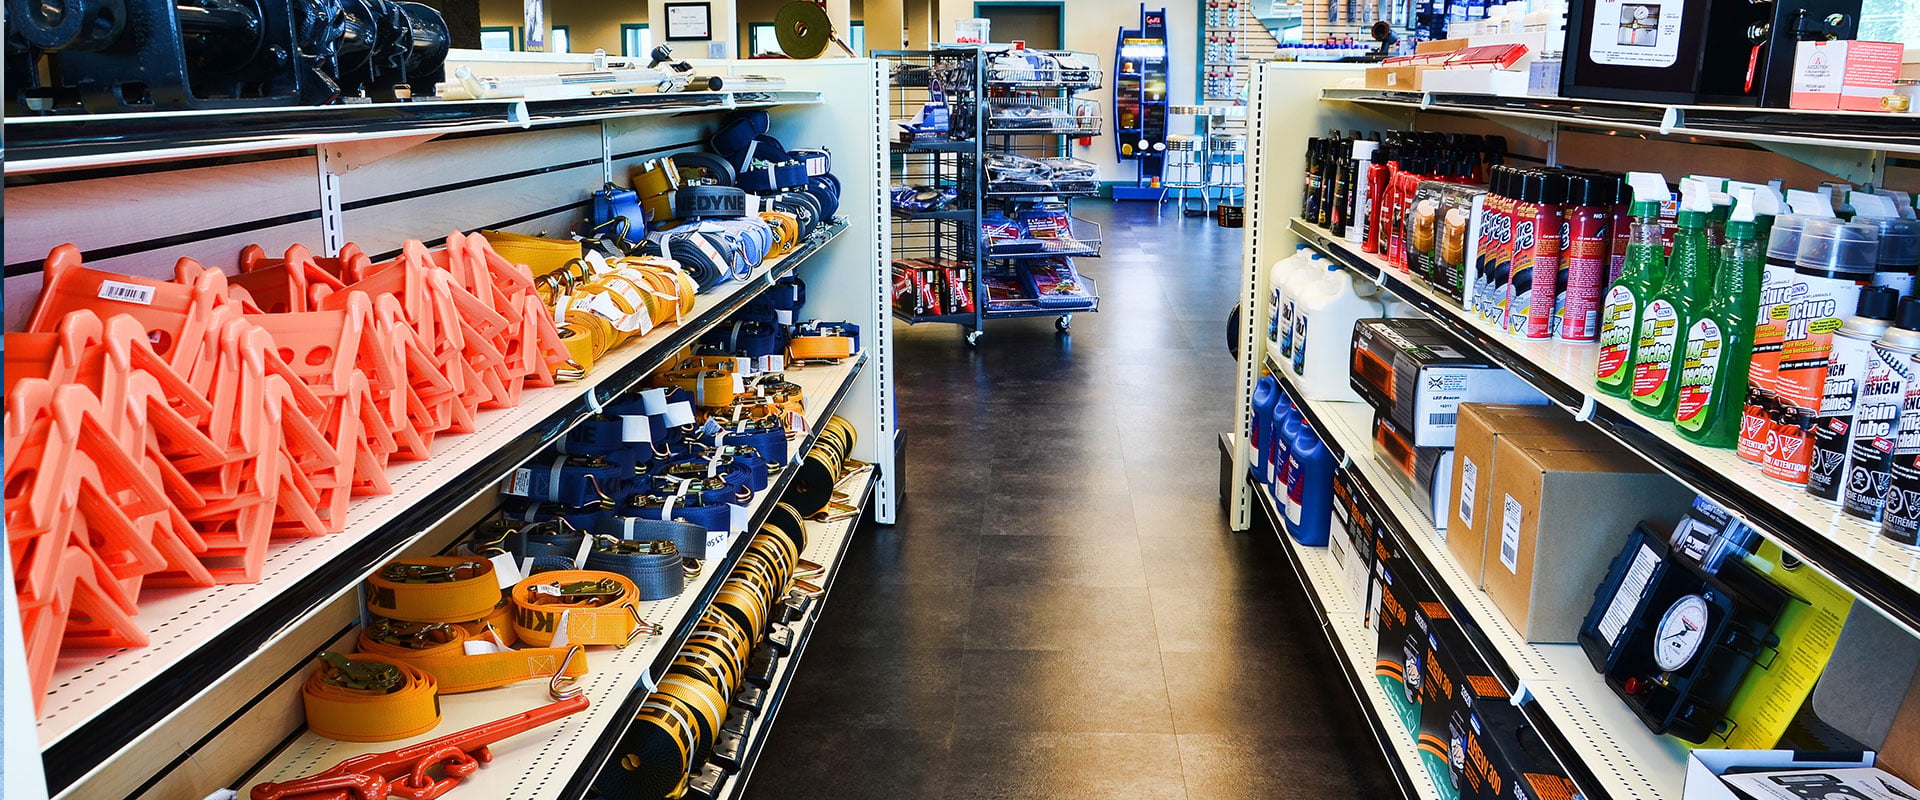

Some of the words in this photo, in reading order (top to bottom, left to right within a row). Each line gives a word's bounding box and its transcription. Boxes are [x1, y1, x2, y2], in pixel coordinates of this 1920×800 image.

[1857, 493, 1886, 508] DANGER
[1888, 513, 1919, 530] EXTRÊME
[1468, 730, 1490, 779] KREW
[1487, 764, 1502, 796] 300
